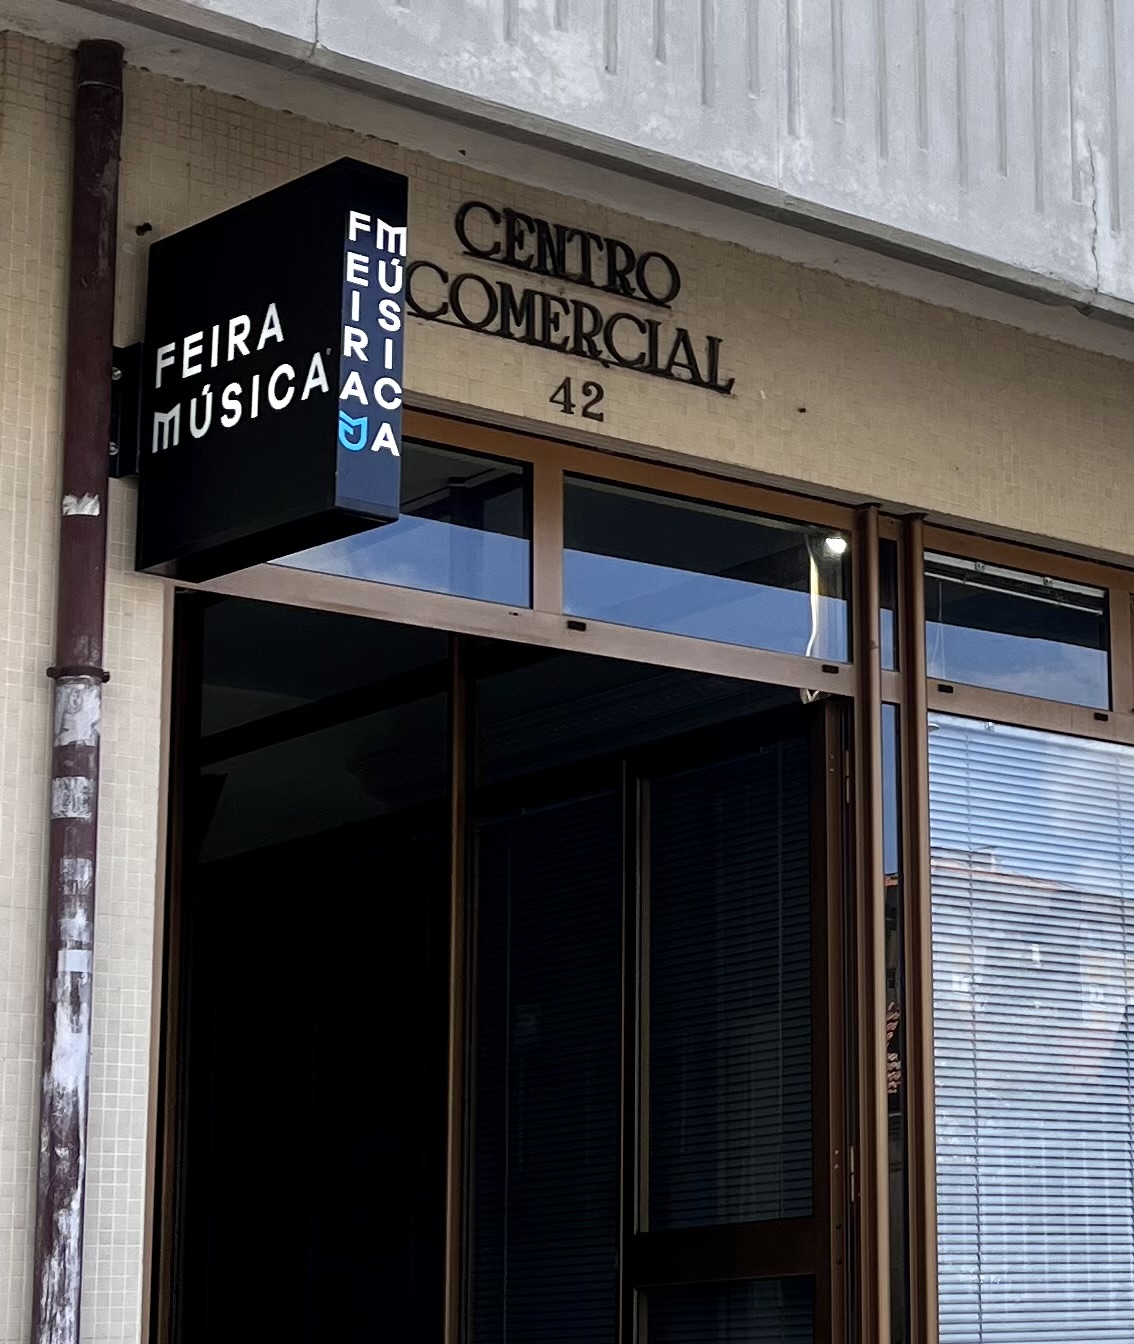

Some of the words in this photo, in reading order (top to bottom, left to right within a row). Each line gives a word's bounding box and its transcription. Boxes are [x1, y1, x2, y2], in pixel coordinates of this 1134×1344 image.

[338, 210, 372, 406] FEIRA
[455, 200, 681, 309] CENTRO
[155, 303, 285, 388] FEIRA
[370, 217, 407, 457] MÚSICA
[405, 260, 735, 395] COMERCIAL
[152, 352, 329, 453] MÚSICA
[549, 376, 604, 422] 42
